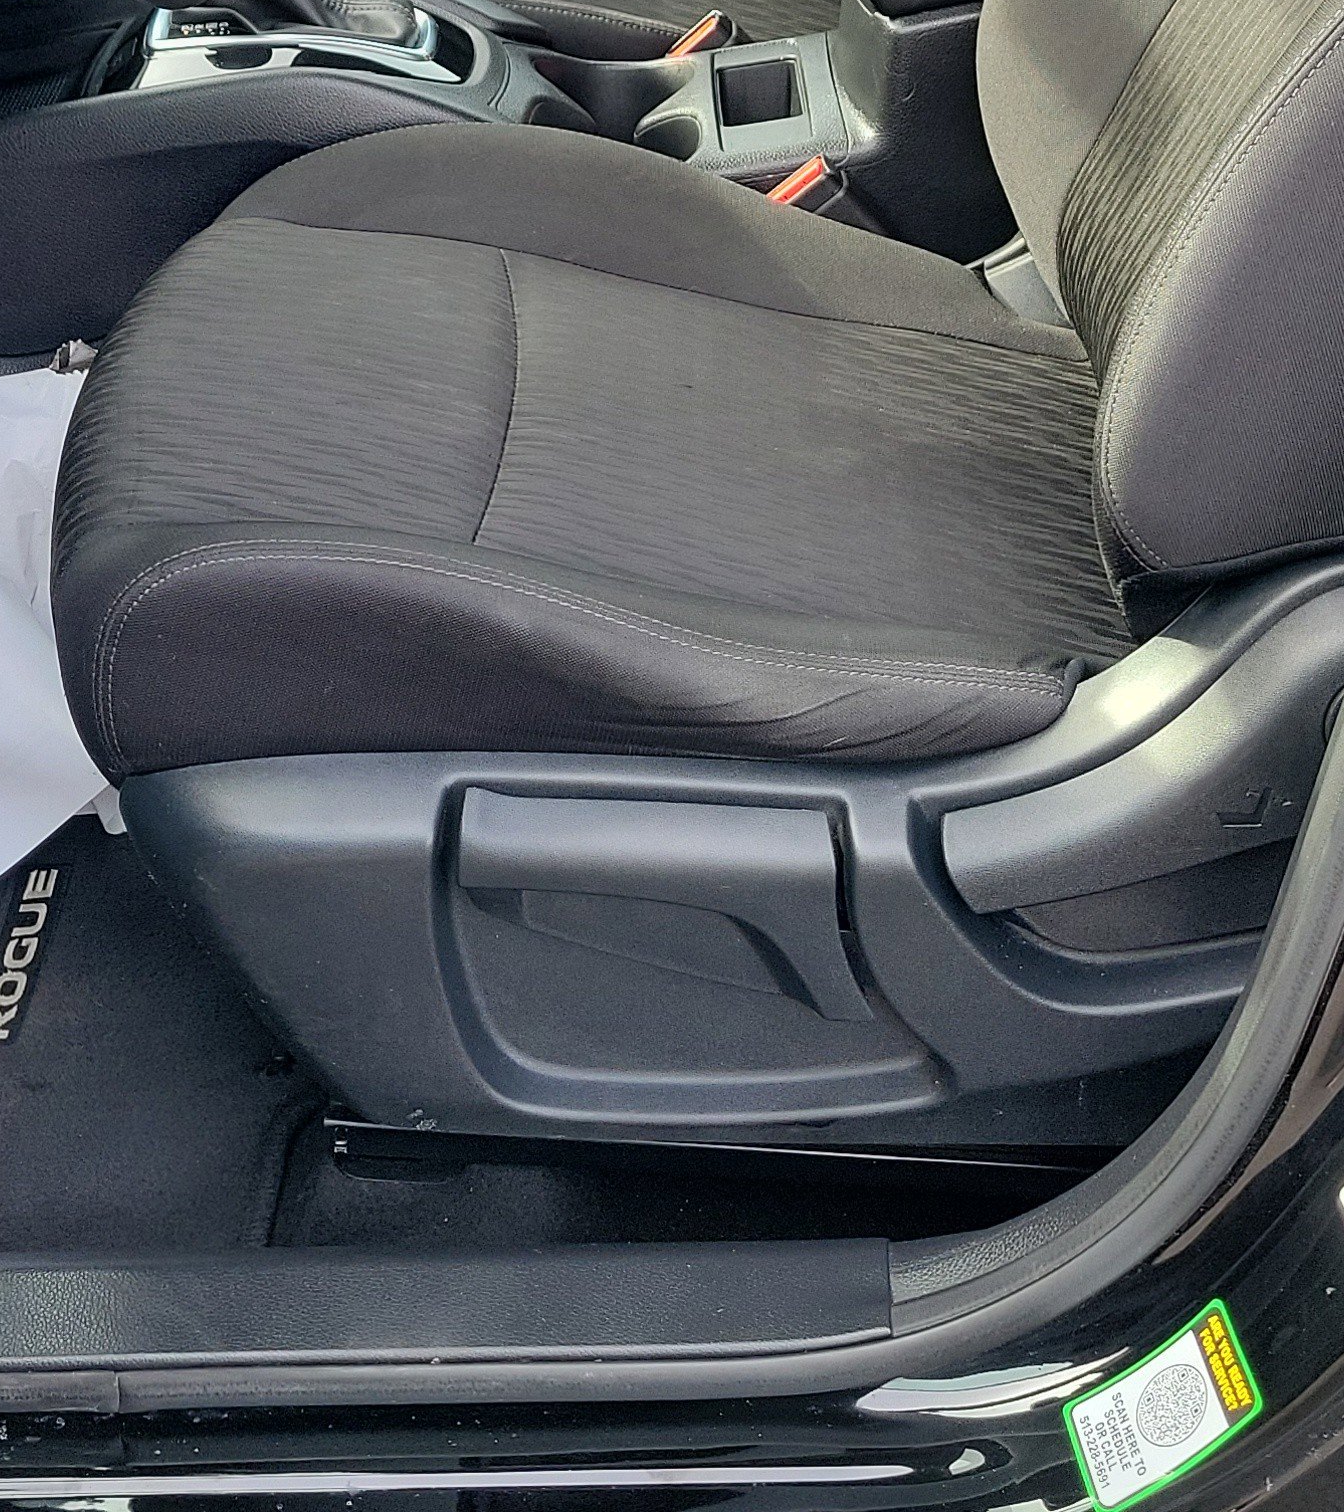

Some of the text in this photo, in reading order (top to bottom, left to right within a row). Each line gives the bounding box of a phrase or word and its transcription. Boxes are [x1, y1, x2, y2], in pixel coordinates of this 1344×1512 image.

[1199, 1327, 1240, 1411] FOR SERVICE?
[1207, 1314, 1254, 1407] ARE YOU READY
[1079, 1417, 1110, 1489] 513-228-5691
[1094, 1421, 1119, 1472] OR CALL
[1104, 1409, 1133, 1472] SCHEDULE
[1112, 1393, 1147, 1476] SCAN HERE TO
